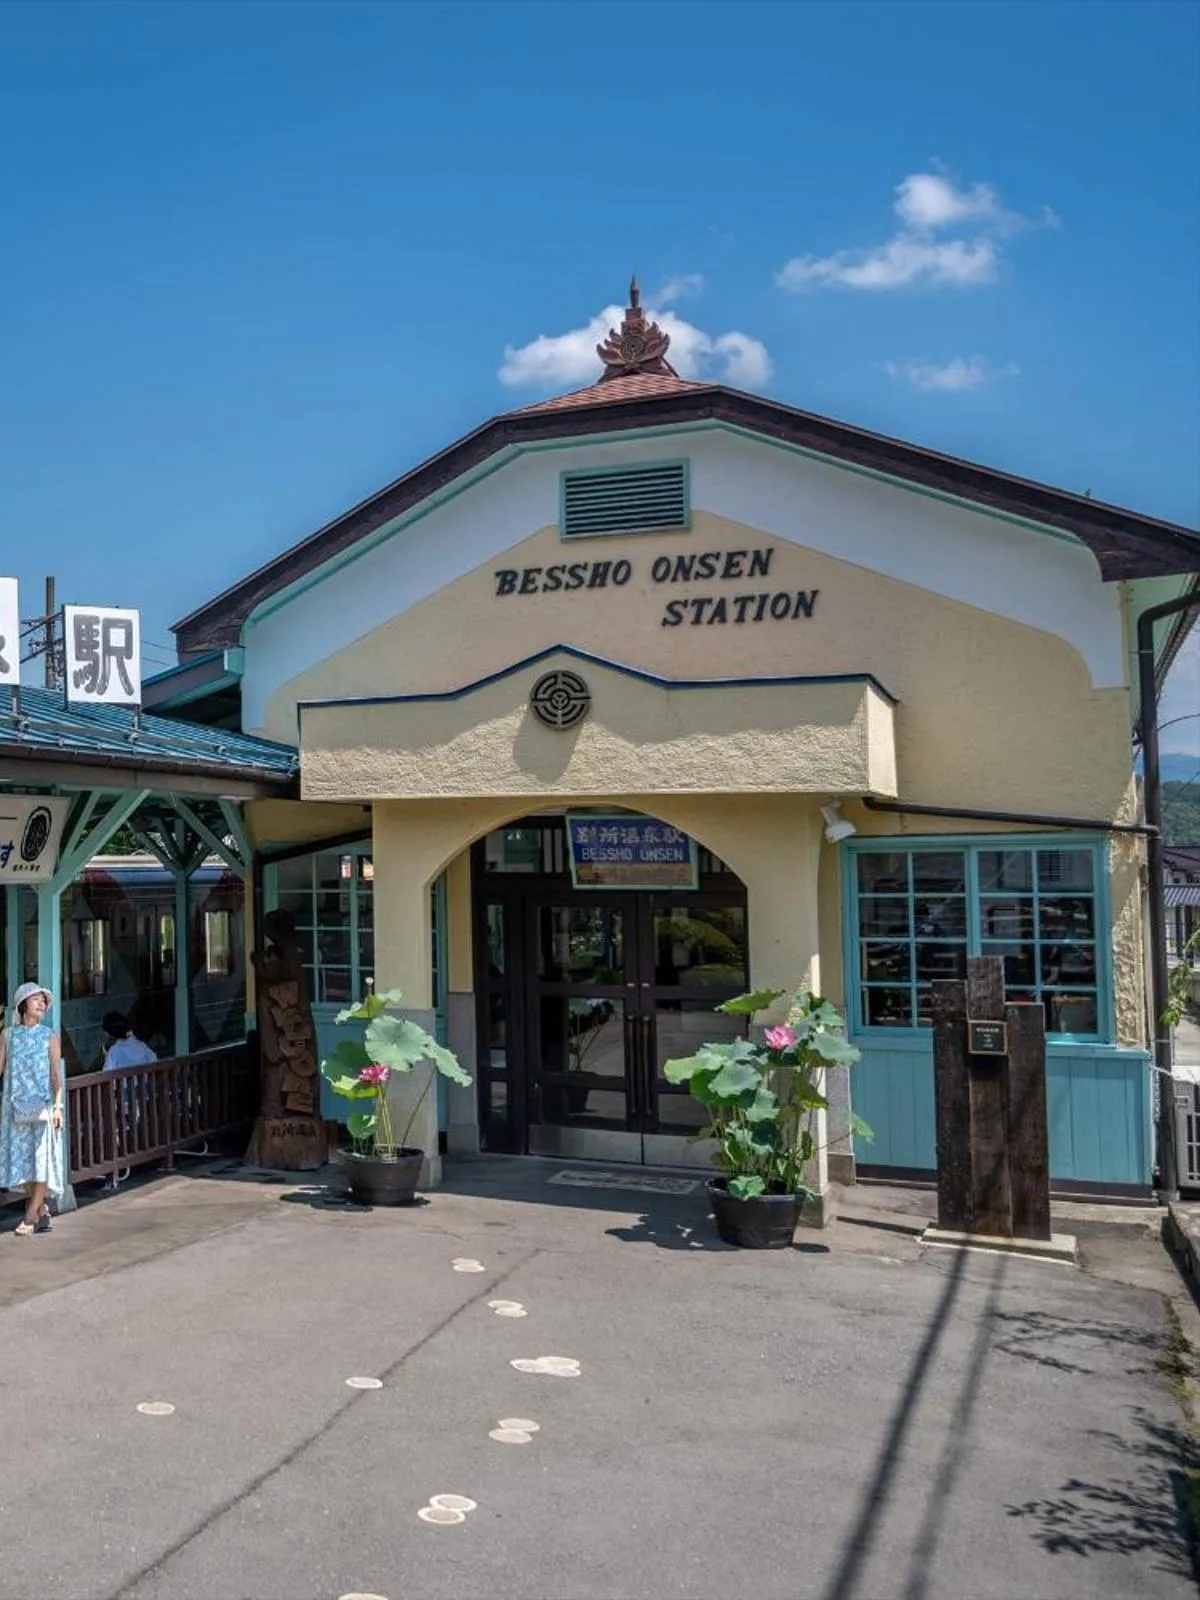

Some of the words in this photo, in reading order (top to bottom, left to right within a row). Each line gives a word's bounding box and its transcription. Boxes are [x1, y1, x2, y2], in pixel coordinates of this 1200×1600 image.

[494, 559, 633, 597] BESSHO
[651, 548, 775, 583] ONSEN
[661, 590, 819, 628] STATION
[72, 613, 135, 697] 駅
[581, 847, 633, 861] BESSHO
[639, 847, 684, 861] ONSEN
